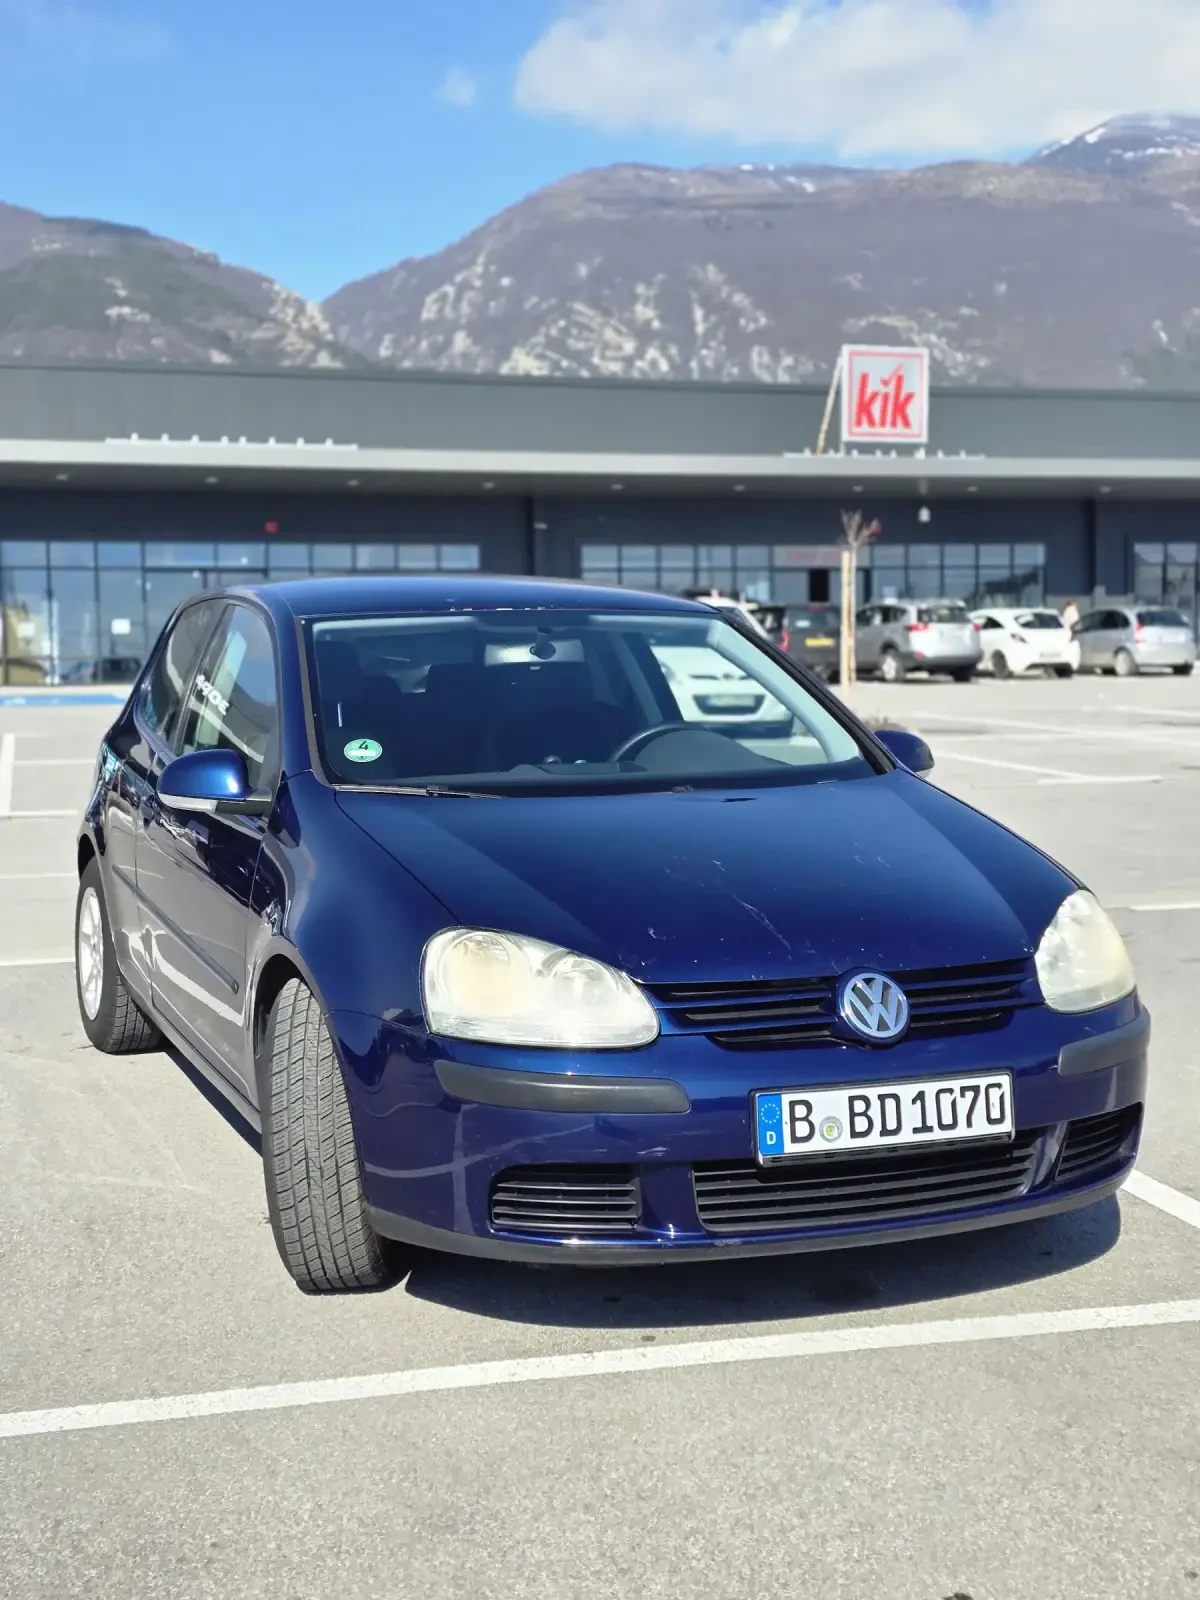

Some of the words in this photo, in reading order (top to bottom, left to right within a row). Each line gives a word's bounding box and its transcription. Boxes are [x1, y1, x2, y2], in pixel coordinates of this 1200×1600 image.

[854, 365, 915, 429] kik
[359, 740, 368, 751] 4
[788, 1099, 815, 1144] B
[766, 1131, 776, 1145] D
